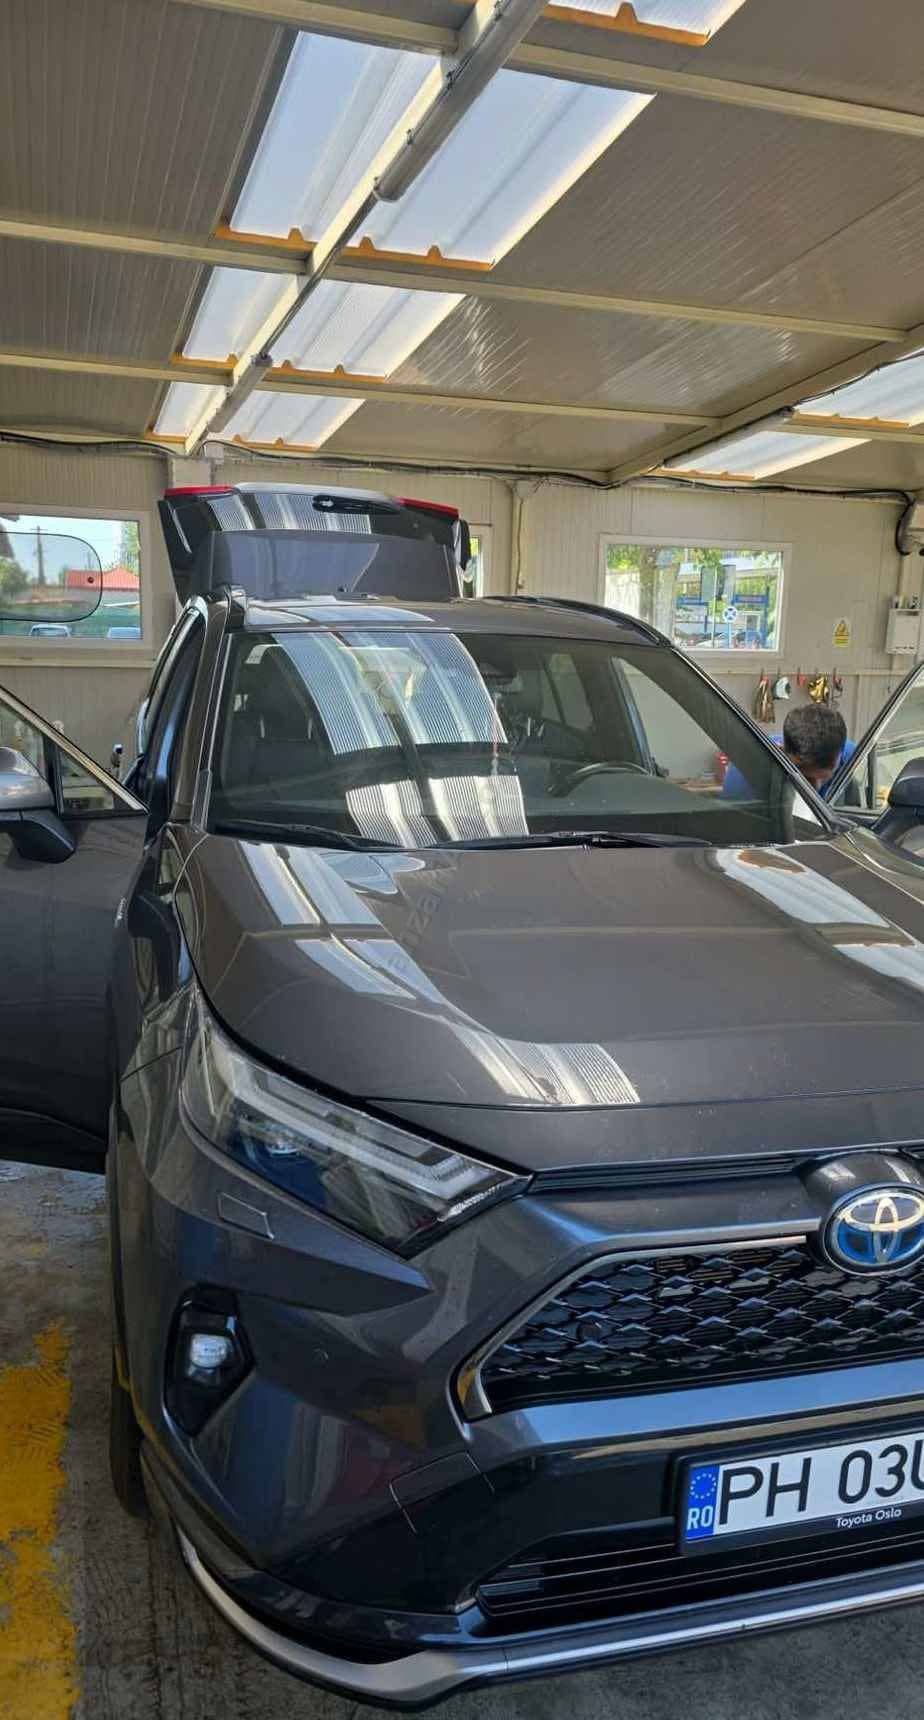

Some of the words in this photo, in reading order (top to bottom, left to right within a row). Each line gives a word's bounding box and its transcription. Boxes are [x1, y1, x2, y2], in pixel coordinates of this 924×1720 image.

[718, 1457, 812, 1525] PH
[686, 1505, 714, 1531] RO
[836, 1513, 873, 1529] Toyota
[874, 1507, 902, 1522] Oslo
